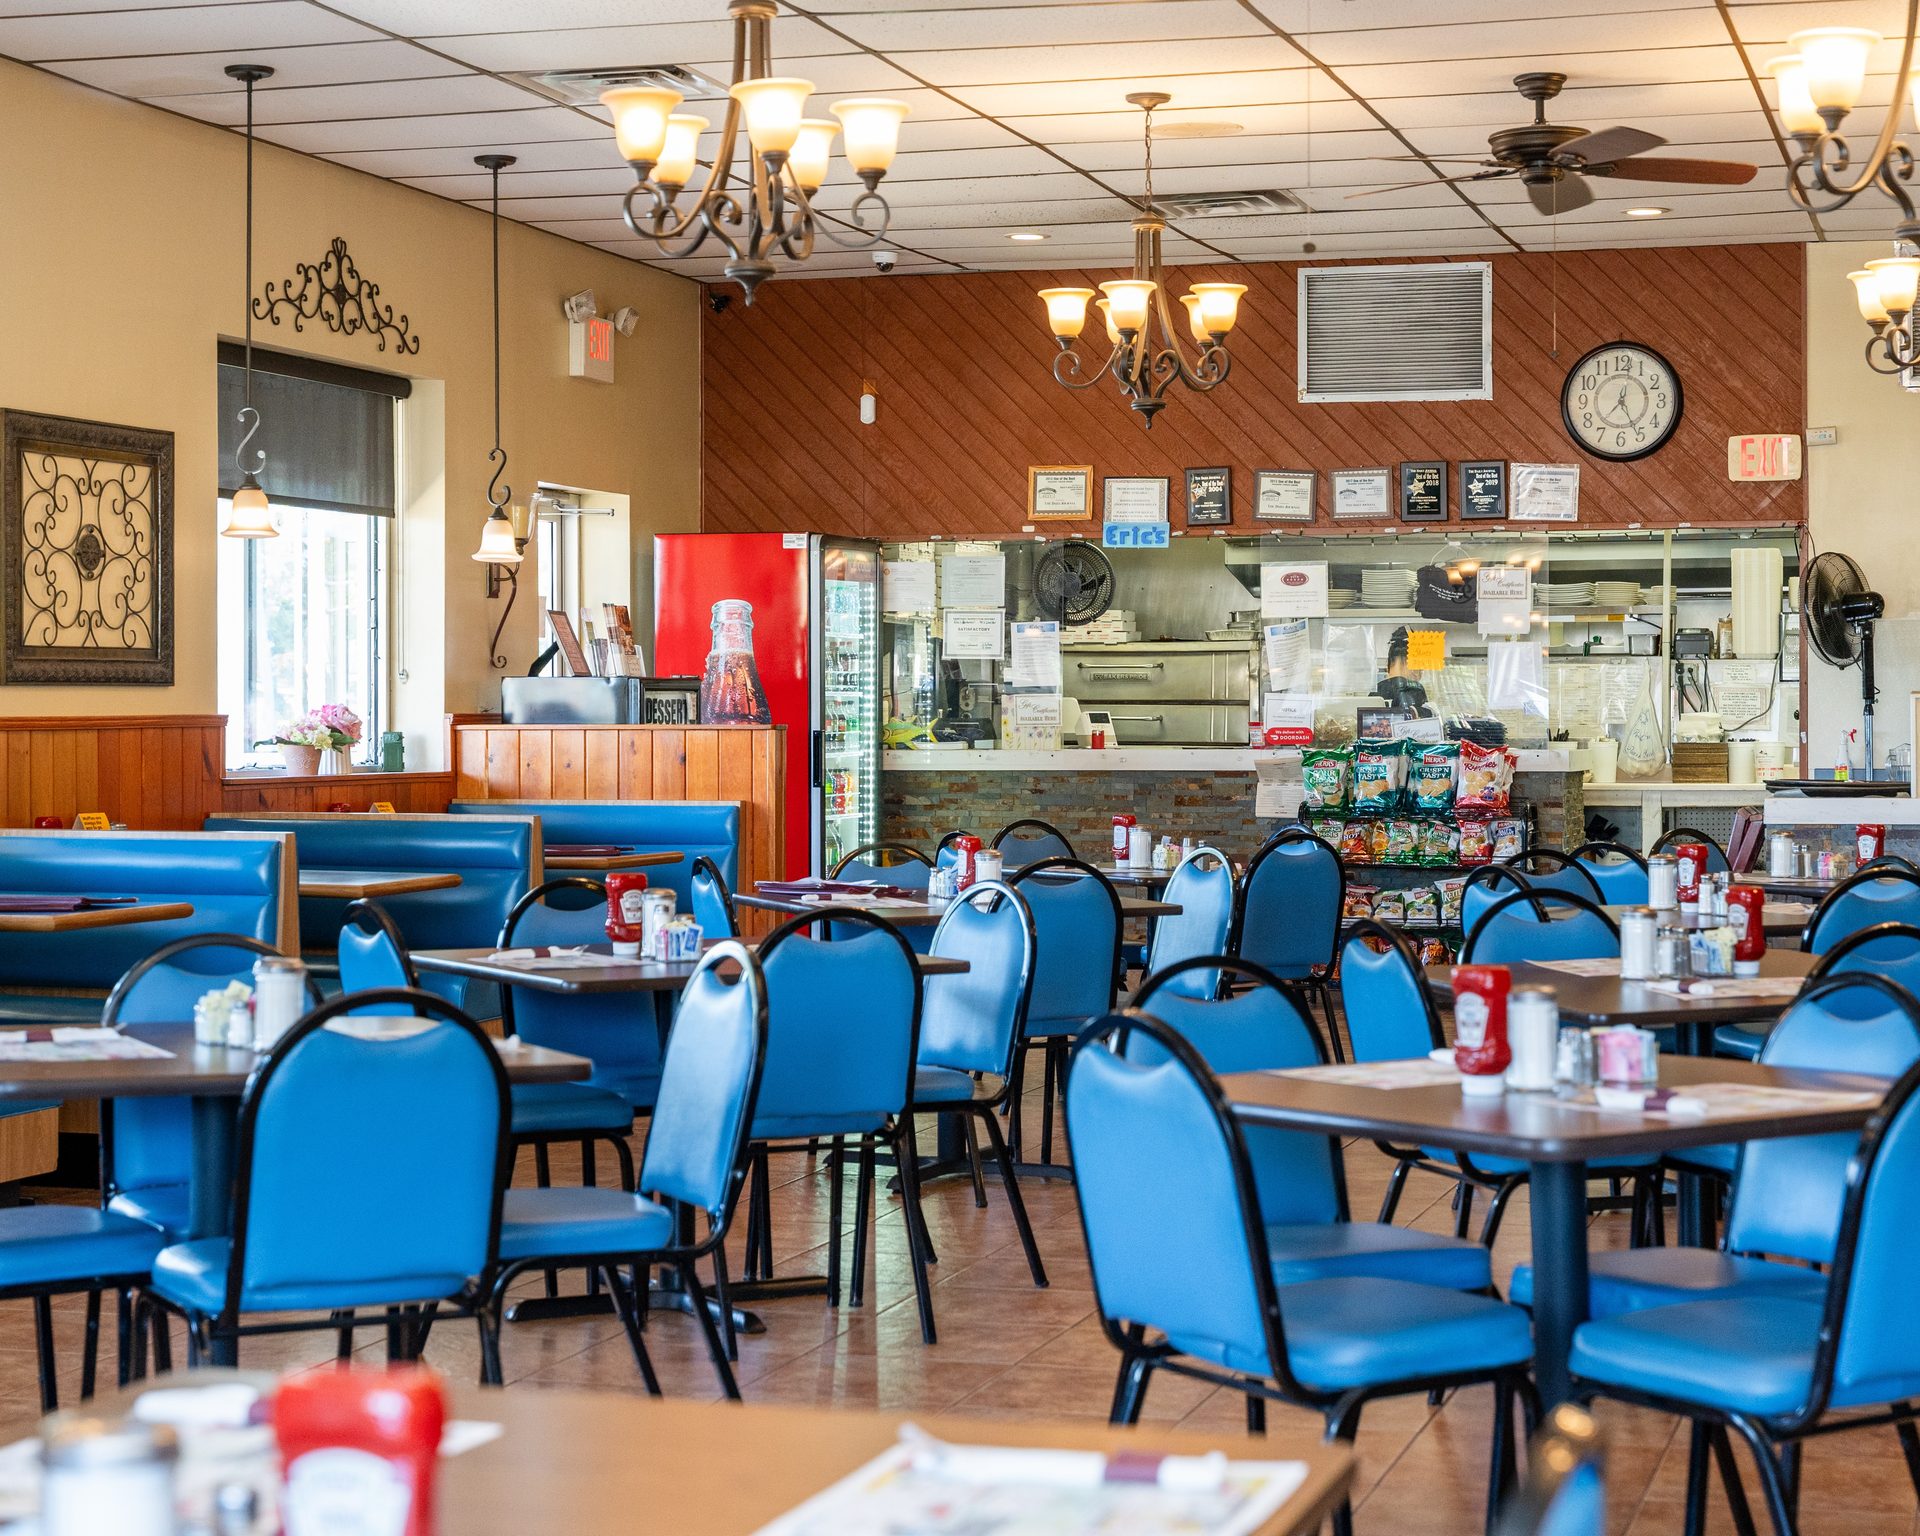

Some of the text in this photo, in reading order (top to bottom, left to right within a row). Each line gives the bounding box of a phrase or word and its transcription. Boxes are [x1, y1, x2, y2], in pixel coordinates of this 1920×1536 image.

[590, 319, 610, 362] EXIT
[1596, 360, 1608, 376] 11
[1614, 355, 1630, 372] 12
[1638, 360, 1644, 376] 1
[1581, 375, 1596, 390] 10
[1650, 374, 1660, 390] 2
[1578, 394, 1588, 410] 9
[1656, 393, 1666, 409] 3
[1582, 412, 1593, 428] 8
[1649, 412, 1660, 428] 4
[1596, 427, 1606, 443] 7
[1616, 431, 1626, 448] 6
[1635, 427, 1646, 442] 5
[1740, 437, 1793, 478] EXIT
